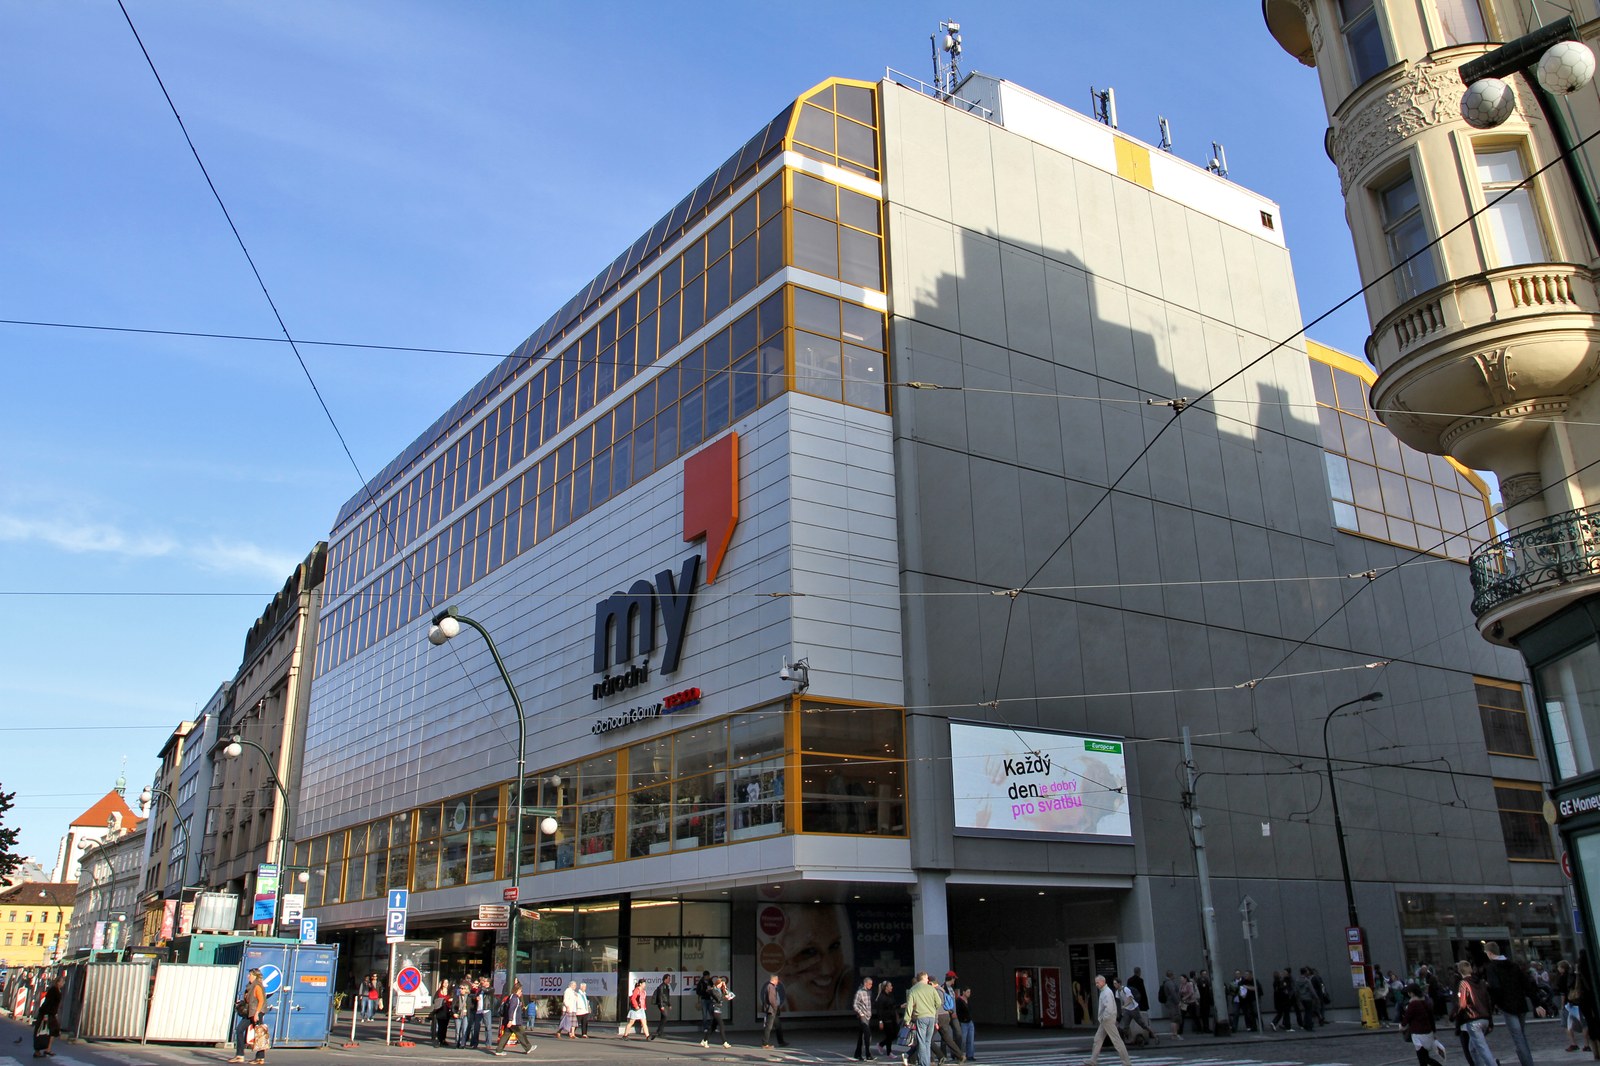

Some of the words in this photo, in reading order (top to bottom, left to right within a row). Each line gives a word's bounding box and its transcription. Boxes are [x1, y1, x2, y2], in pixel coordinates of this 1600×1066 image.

[594, 555, 701, 676] my
[663, 688, 701, 709] TESCO
[1091, 742, 1115, 751] Europcar
[1003, 754, 1051, 776] Každý
[1008, 782, 1039, 800] den
[1039, 783, 1048, 797] je
[1050, 778, 1077, 794] dobrý
[1011, 802, 1035, 819] pro
[1038, 795, 1083, 813] svatbu
[1559, 800, 1573, 816] GE
[1572, 794, 1600, 813] Money
[303, 921, 314, 935] P
[390, 912, 403, 929] P
[856, 920, 913, 930] kontaktn
[540, 977, 562, 987] TESCO
[683, 975, 729, 987] TECO
